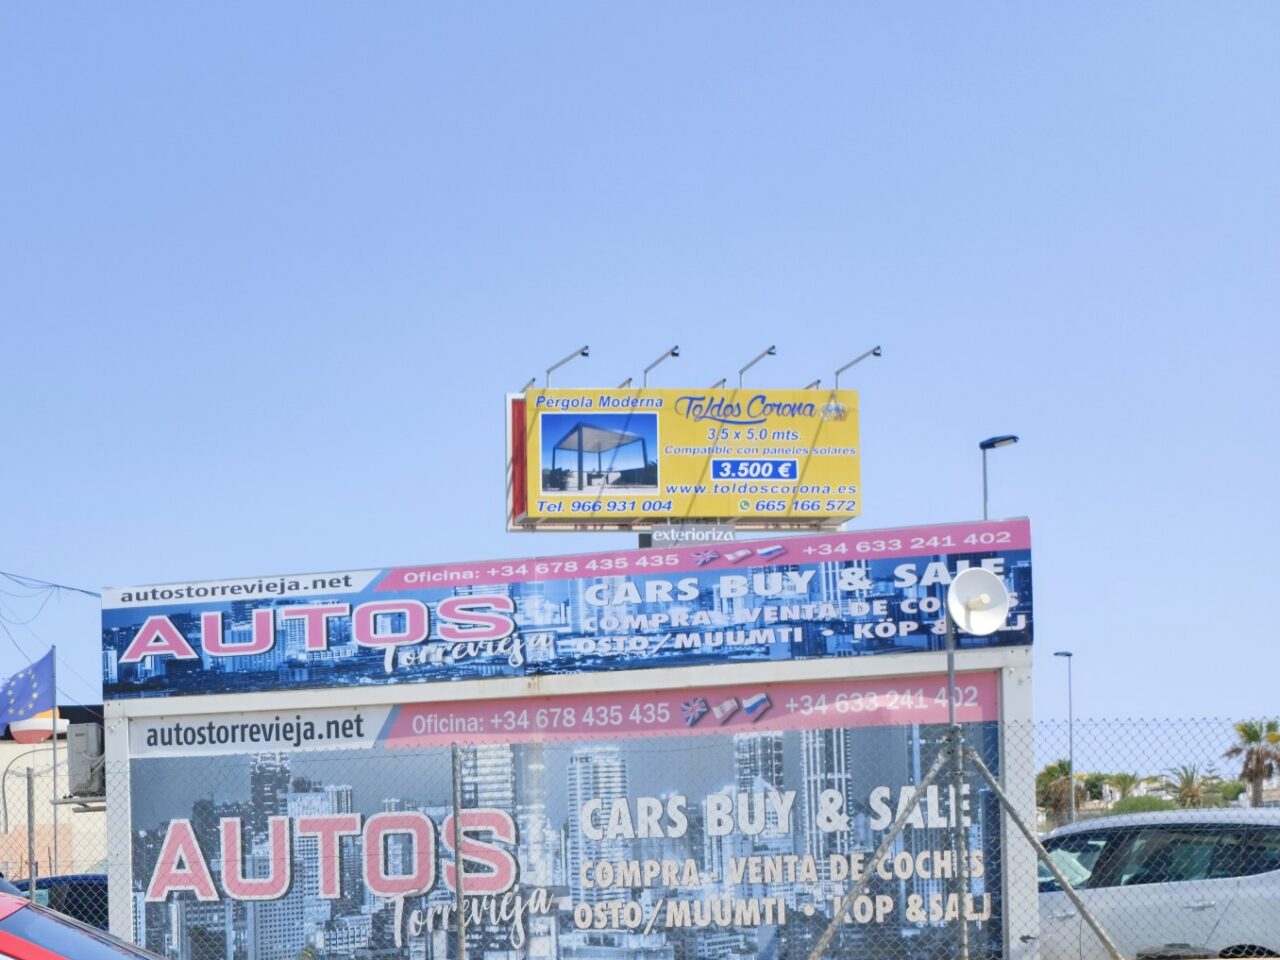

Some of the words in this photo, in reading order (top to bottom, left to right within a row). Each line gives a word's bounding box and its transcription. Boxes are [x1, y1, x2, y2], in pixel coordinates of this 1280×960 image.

[598, 395, 664, 408] Moderna
[674, 395, 741, 422] Toldos
[747, 394, 817, 418] Corona
[707, 427, 729, 441] 3,5
[733, 430, 741, 440] x
[746, 427, 768, 441] 5,0
[663, 444, 733, 457] Compatible
[736, 446, 759, 455] con
[762, 445, 809, 457] paneles
[813, 445, 856, 455] solares
[719, 463, 773, 478] 3.500
[778, 463, 791, 478] €
[665, 483, 857, 495] www.toldoscorona.es
[536, 500, 565, 512] Tel.
[571, 500, 602, 512] 966
[606, 500, 636, 512] 931
[641, 500, 673, 512] 004
[755, 500, 786, 512] 665
[792, 500, 821, 512] 166
[825, 500, 856, 512] 572
[652, 527, 735, 542] exterioriza
[802, 543, 850, 557] +34
[855, 539, 906, 553] 633
[908, 535, 953, 549] 241
[963, 531, 1013, 545] 402
[404, 568, 480, 584] Oficina:
[487, 564, 529, 578] +34
[535, 560, 579, 575] 678
[584, 556, 631, 571] 435
[635, 553, 680, 569] 435
[120, 573, 352, 603] autostorrevieja.net
[584, 577, 700, 607] CARS
[720, 568, 818, 599] BUY
[838, 567, 872, 592] &
[120, 595, 517, 664] AUTOS
[582, 610, 712, 632] COMPRA
[742, 602, 839, 623] VENTA
[850, 599, 888, 617] DE
[853, 618, 919, 639] KÖP
[381, 633, 554, 674] Torrevieja
[785, 694, 828, 716] +34
[834, 691, 879, 714] 633
[885, 688, 929, 711] 241
[146, 713, 365, 747] autostorrevieja.net
[412, 714, 485, 736] Oficina:
[490, 710, 530, 731] +34
[535, 706, 576, 728] 678
[582, 704, 623, 727] 435
[629, 702, 670, 724] 435
[581, 794, 690, 841] CARS
[706, 788, 798, 837] BUY
[816, 787, 851, 834] &
[146, 807, 519, 903] AUTOS
[580, 857, 701, 890] COMPRA
[729, 853, 818, 885] VENTA
[830, 852, 865, 882] DE
[381, 884, 554, 949] Torrevieja
